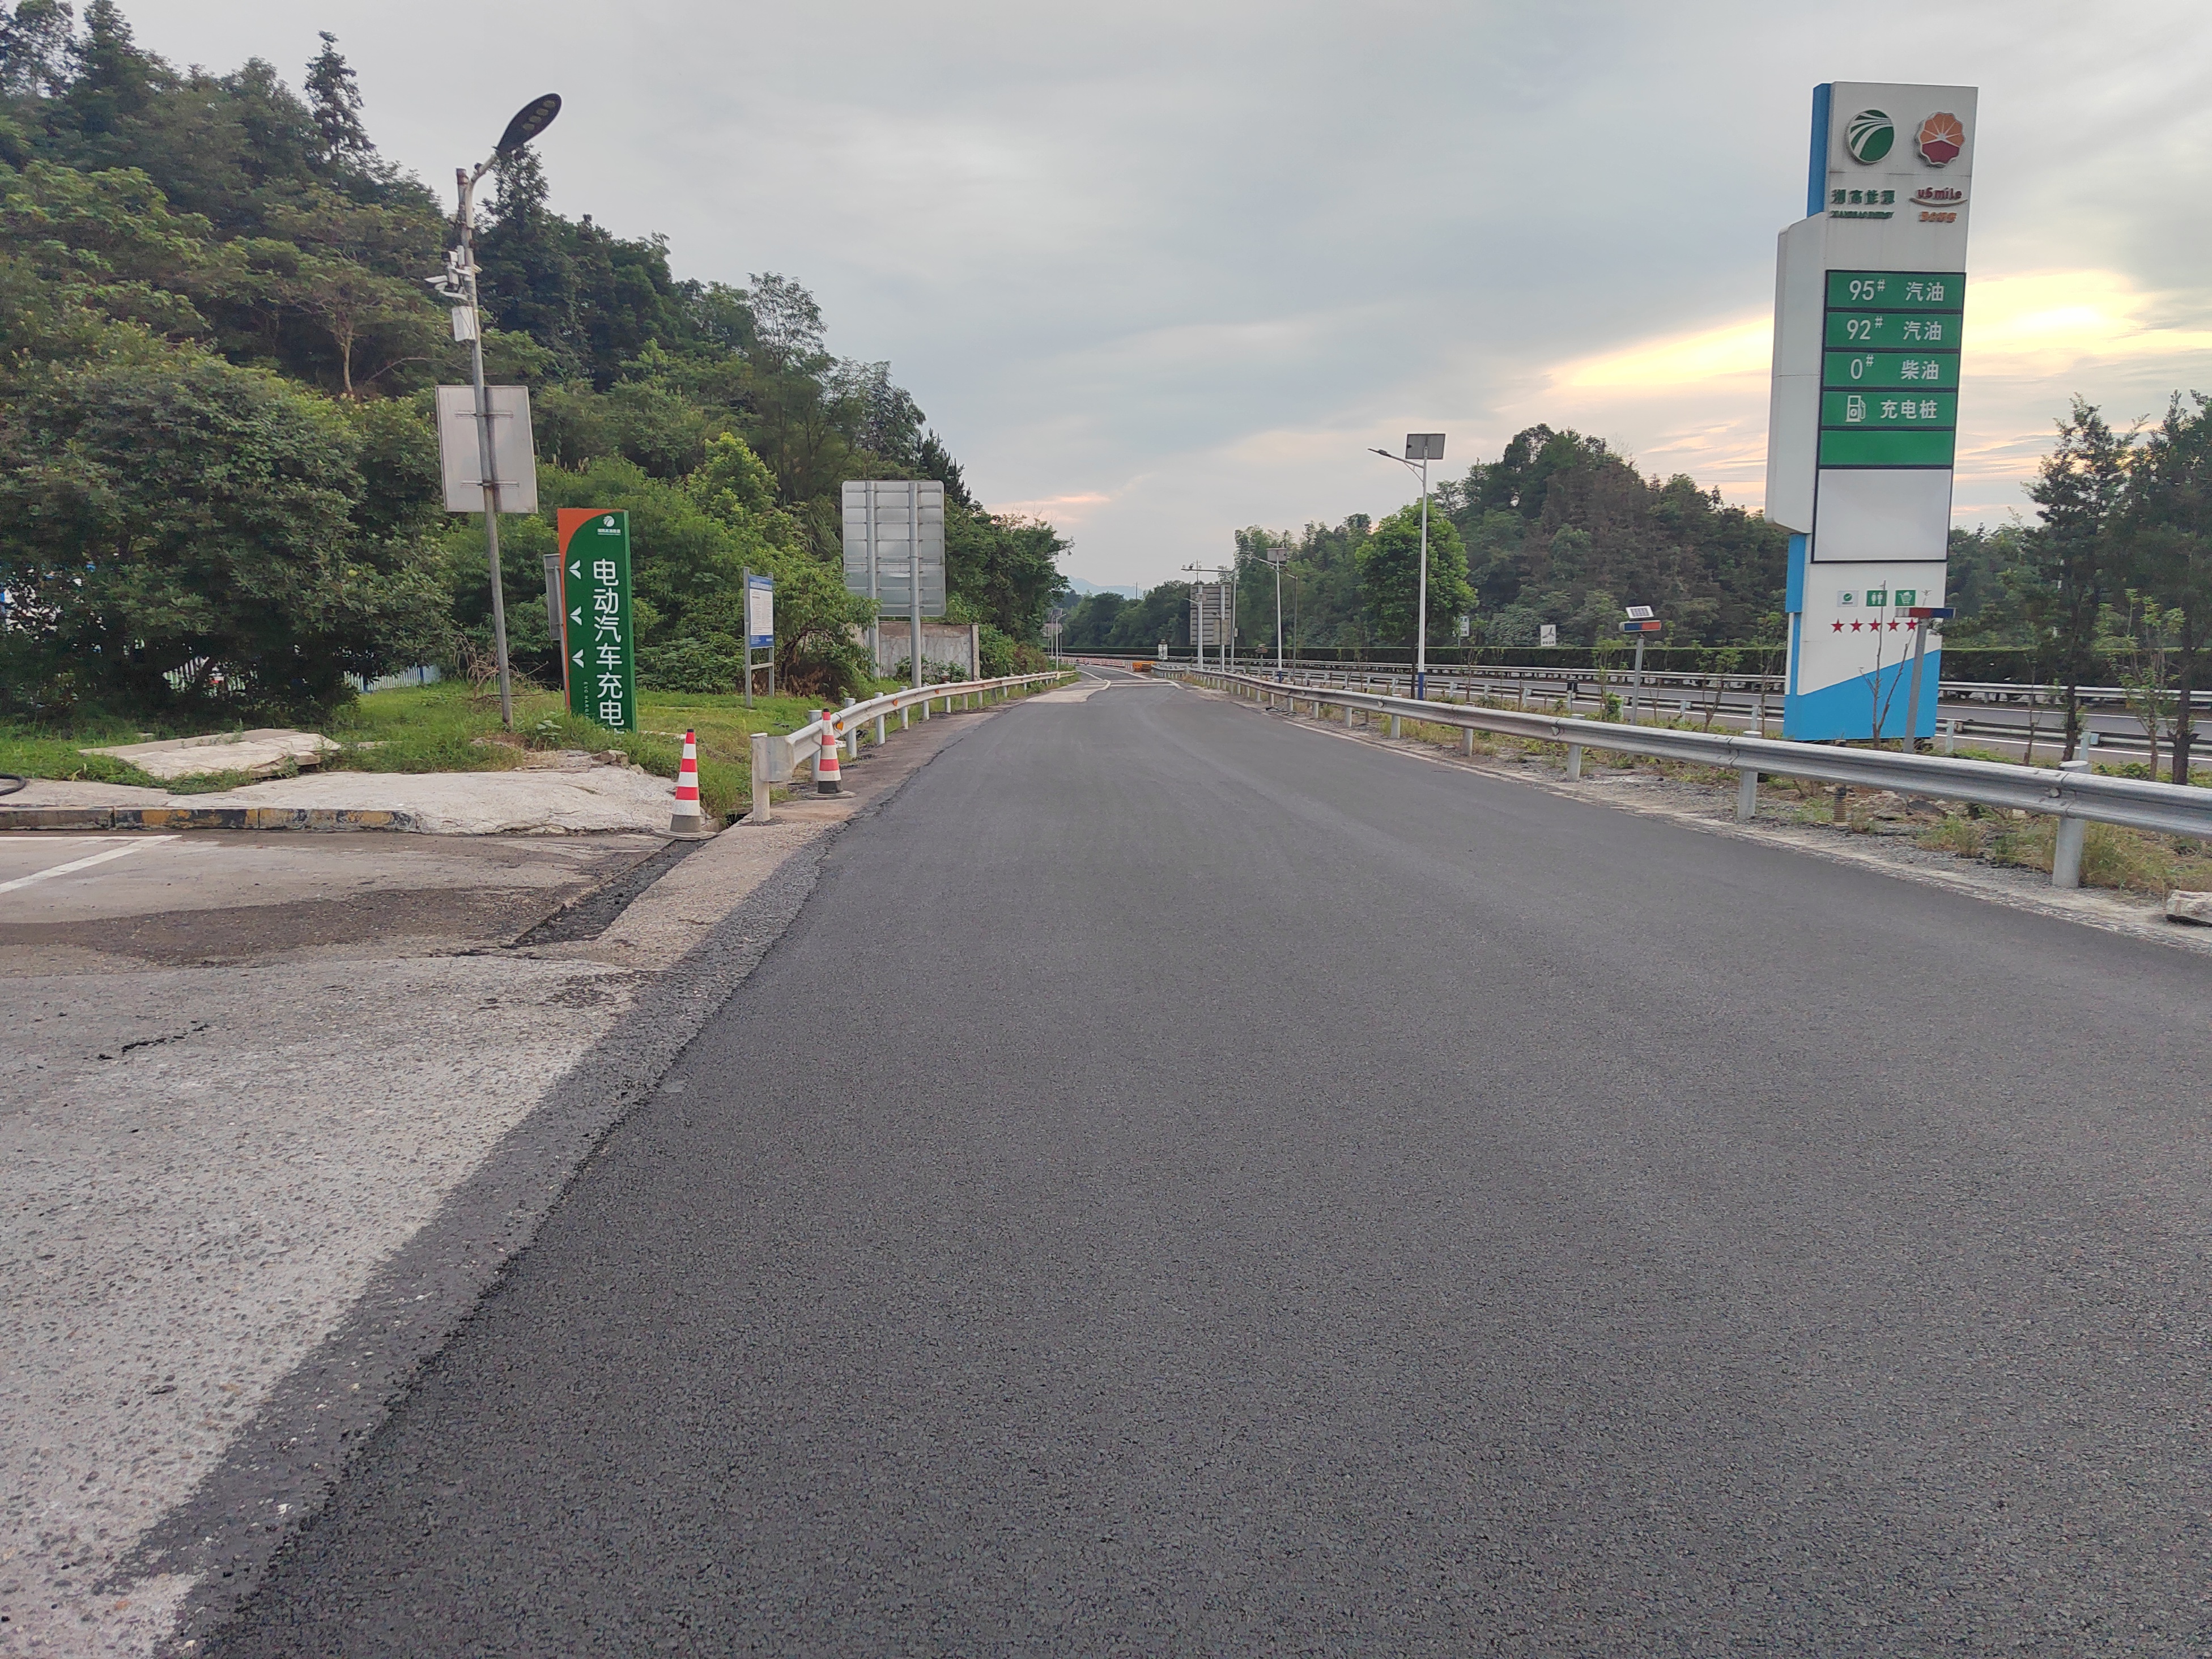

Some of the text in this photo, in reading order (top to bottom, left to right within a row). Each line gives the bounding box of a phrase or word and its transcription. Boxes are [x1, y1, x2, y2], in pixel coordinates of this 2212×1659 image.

[1849, 279, 1945, 302] 95# 汽油
[1847, 316, 1942, 341] 92# 汽油
[1900, 359, 1939, 380] 柴油
[1880, 399, 1938, 420] 充电桩
